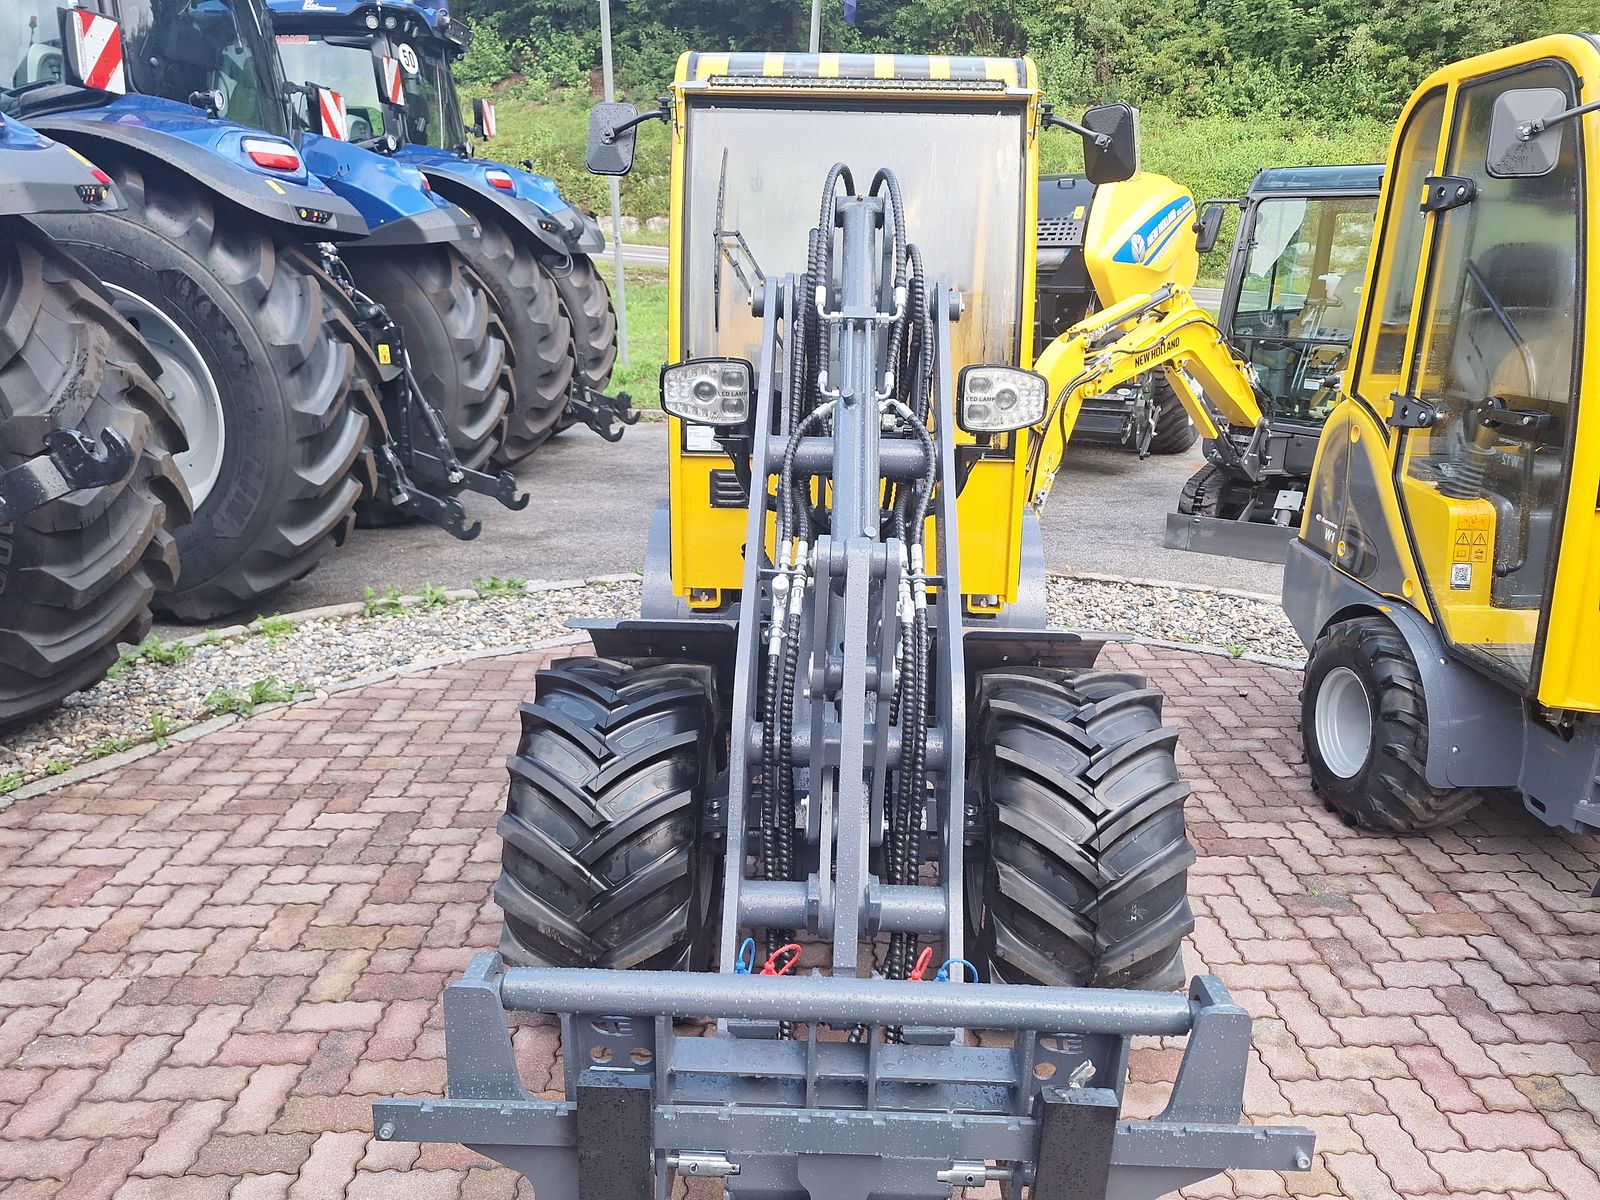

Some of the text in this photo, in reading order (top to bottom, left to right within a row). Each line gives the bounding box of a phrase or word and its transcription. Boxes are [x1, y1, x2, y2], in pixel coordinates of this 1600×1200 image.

[402, 49, 416, 68] 50
[1134, 337, 1180, 368] NEW HOLLAND
